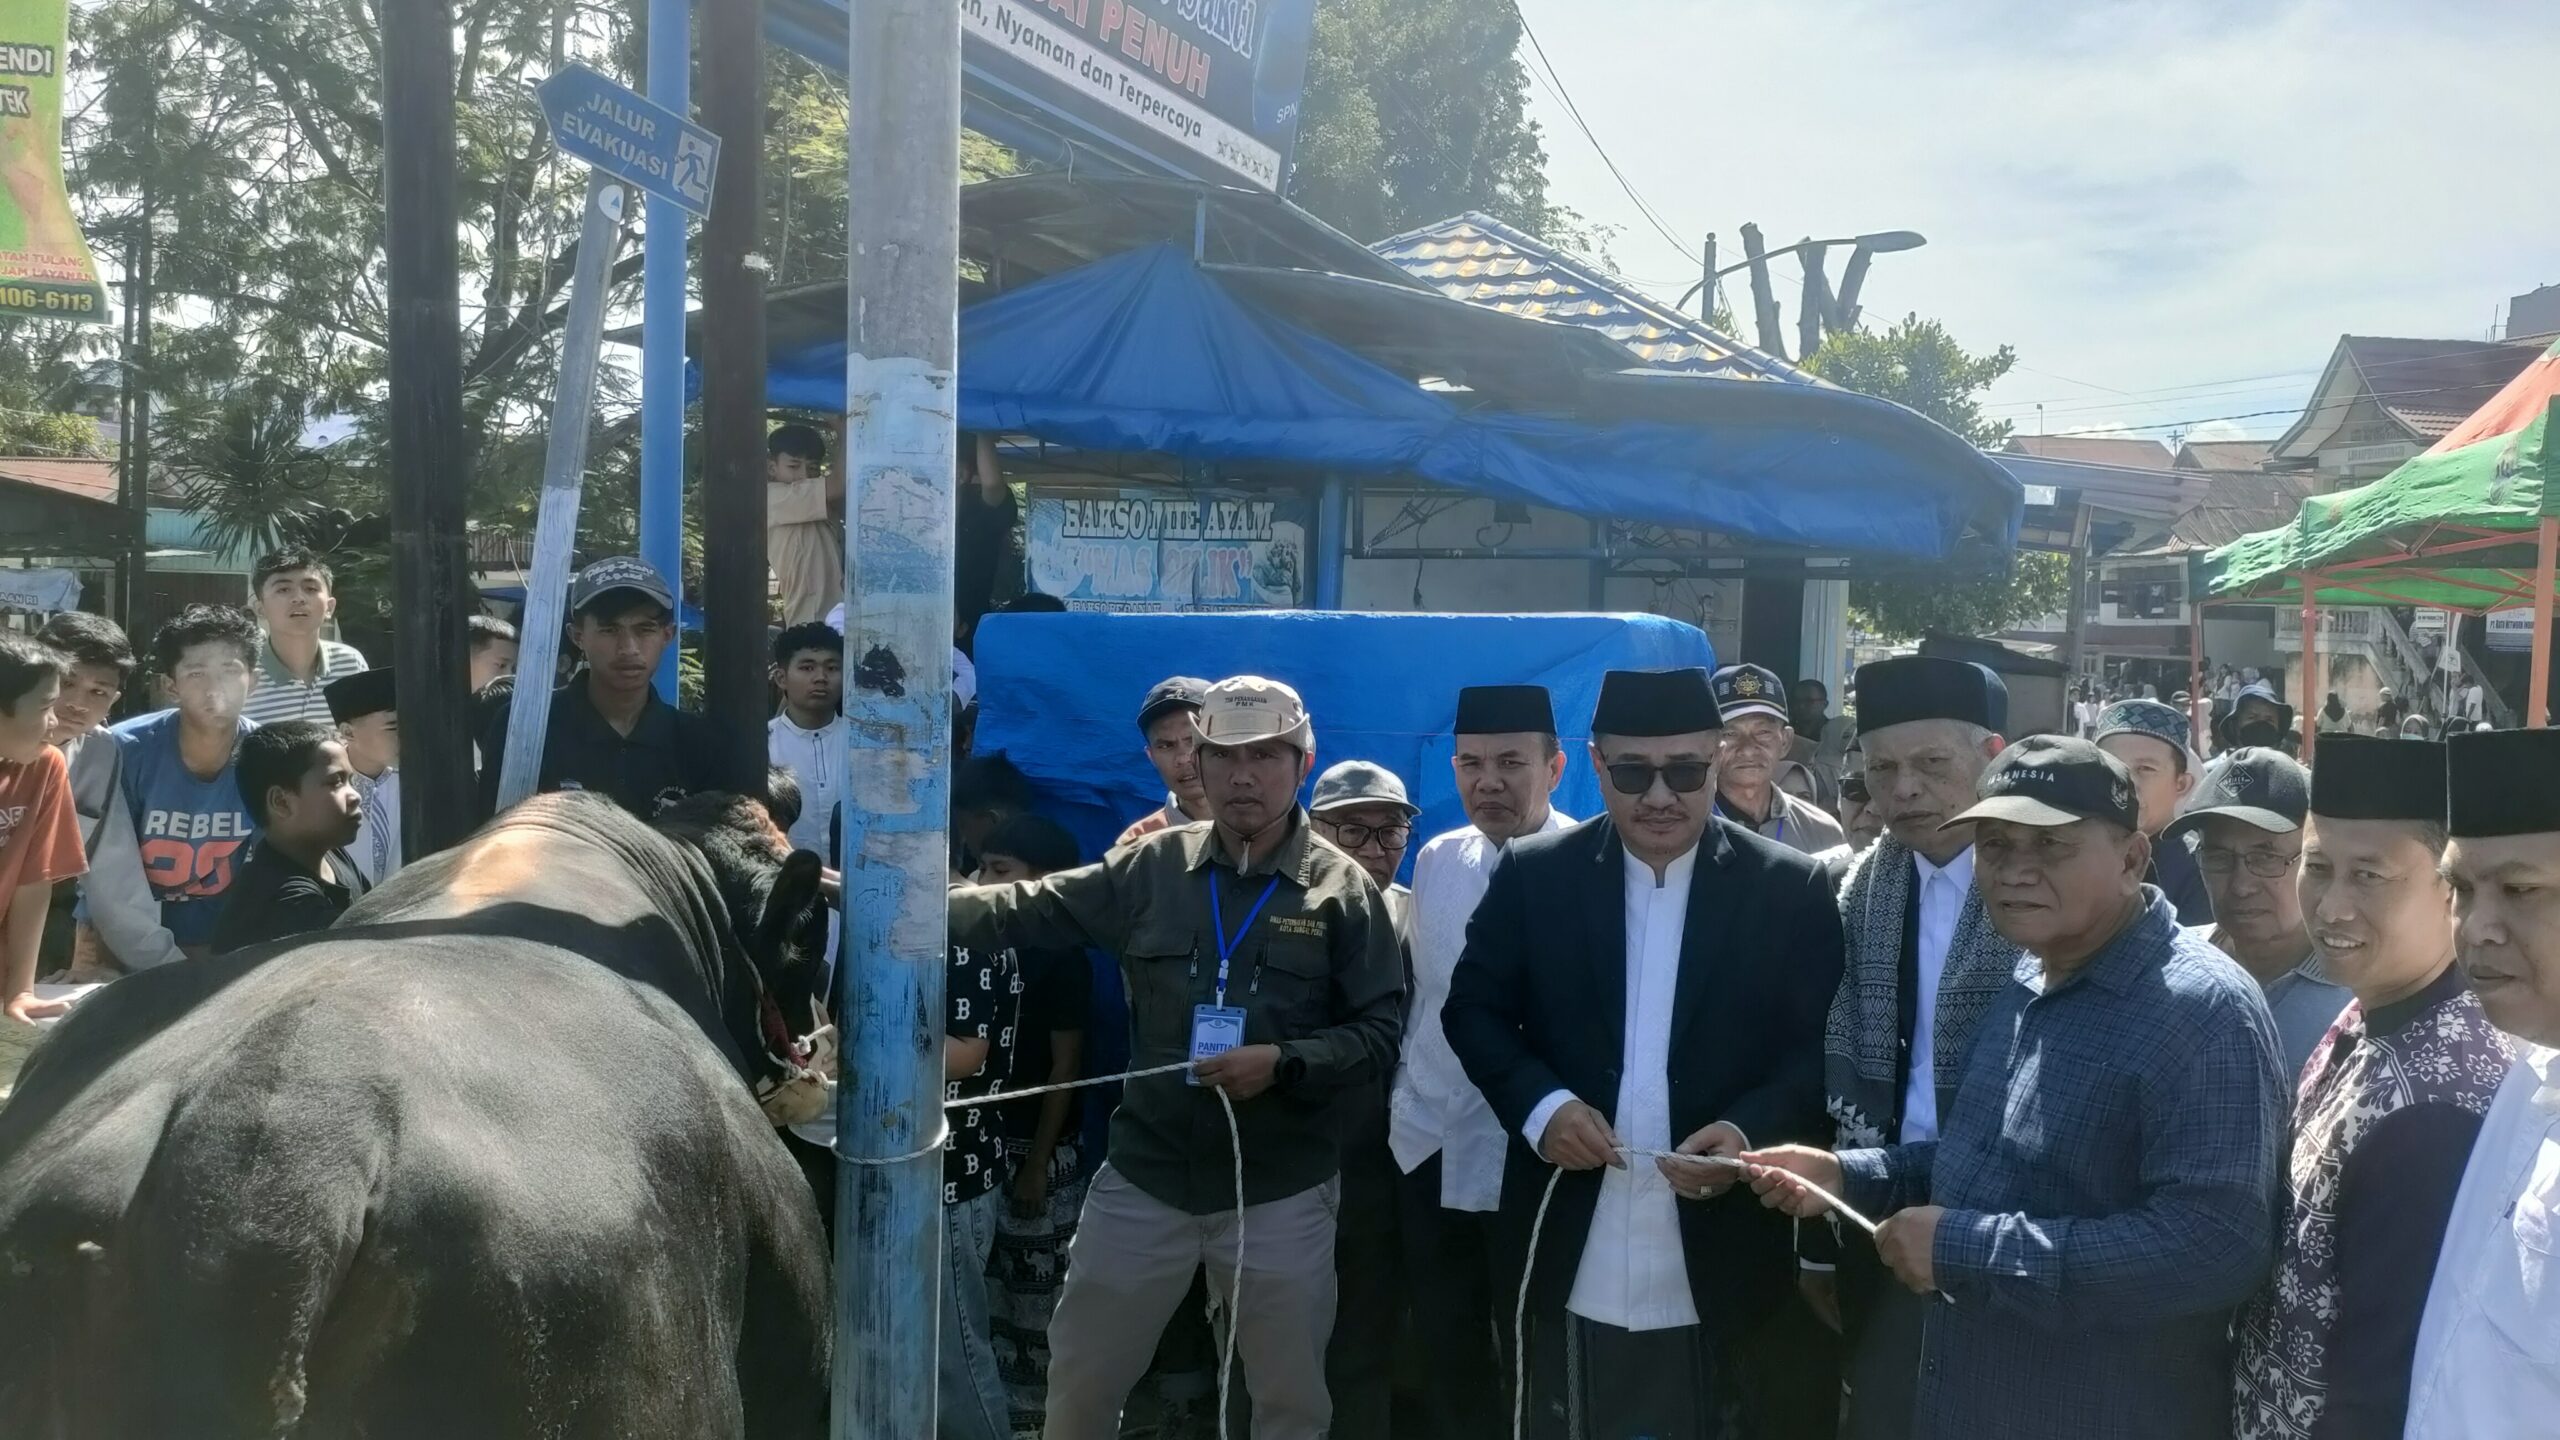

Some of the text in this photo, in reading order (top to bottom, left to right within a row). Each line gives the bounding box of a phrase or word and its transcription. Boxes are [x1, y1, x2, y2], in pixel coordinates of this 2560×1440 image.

[996, 4, 1075, 70] Nyaman
[1080, 55, 1113, 91] dan
[1118, 73, 1202, 138] Terpercaya
[1100, 0, 1211, 99] PENUH
[586, 94, 656, 141] JALUR
[561, 112, 669, 181] EVAKUASI
[32, 254, 85, 267] TULANG
[1062, 499, 1149, 539] BAKSO
[1203, 502, 1275, 541] AYAM
[145, 810, 252, 839] REBEL
